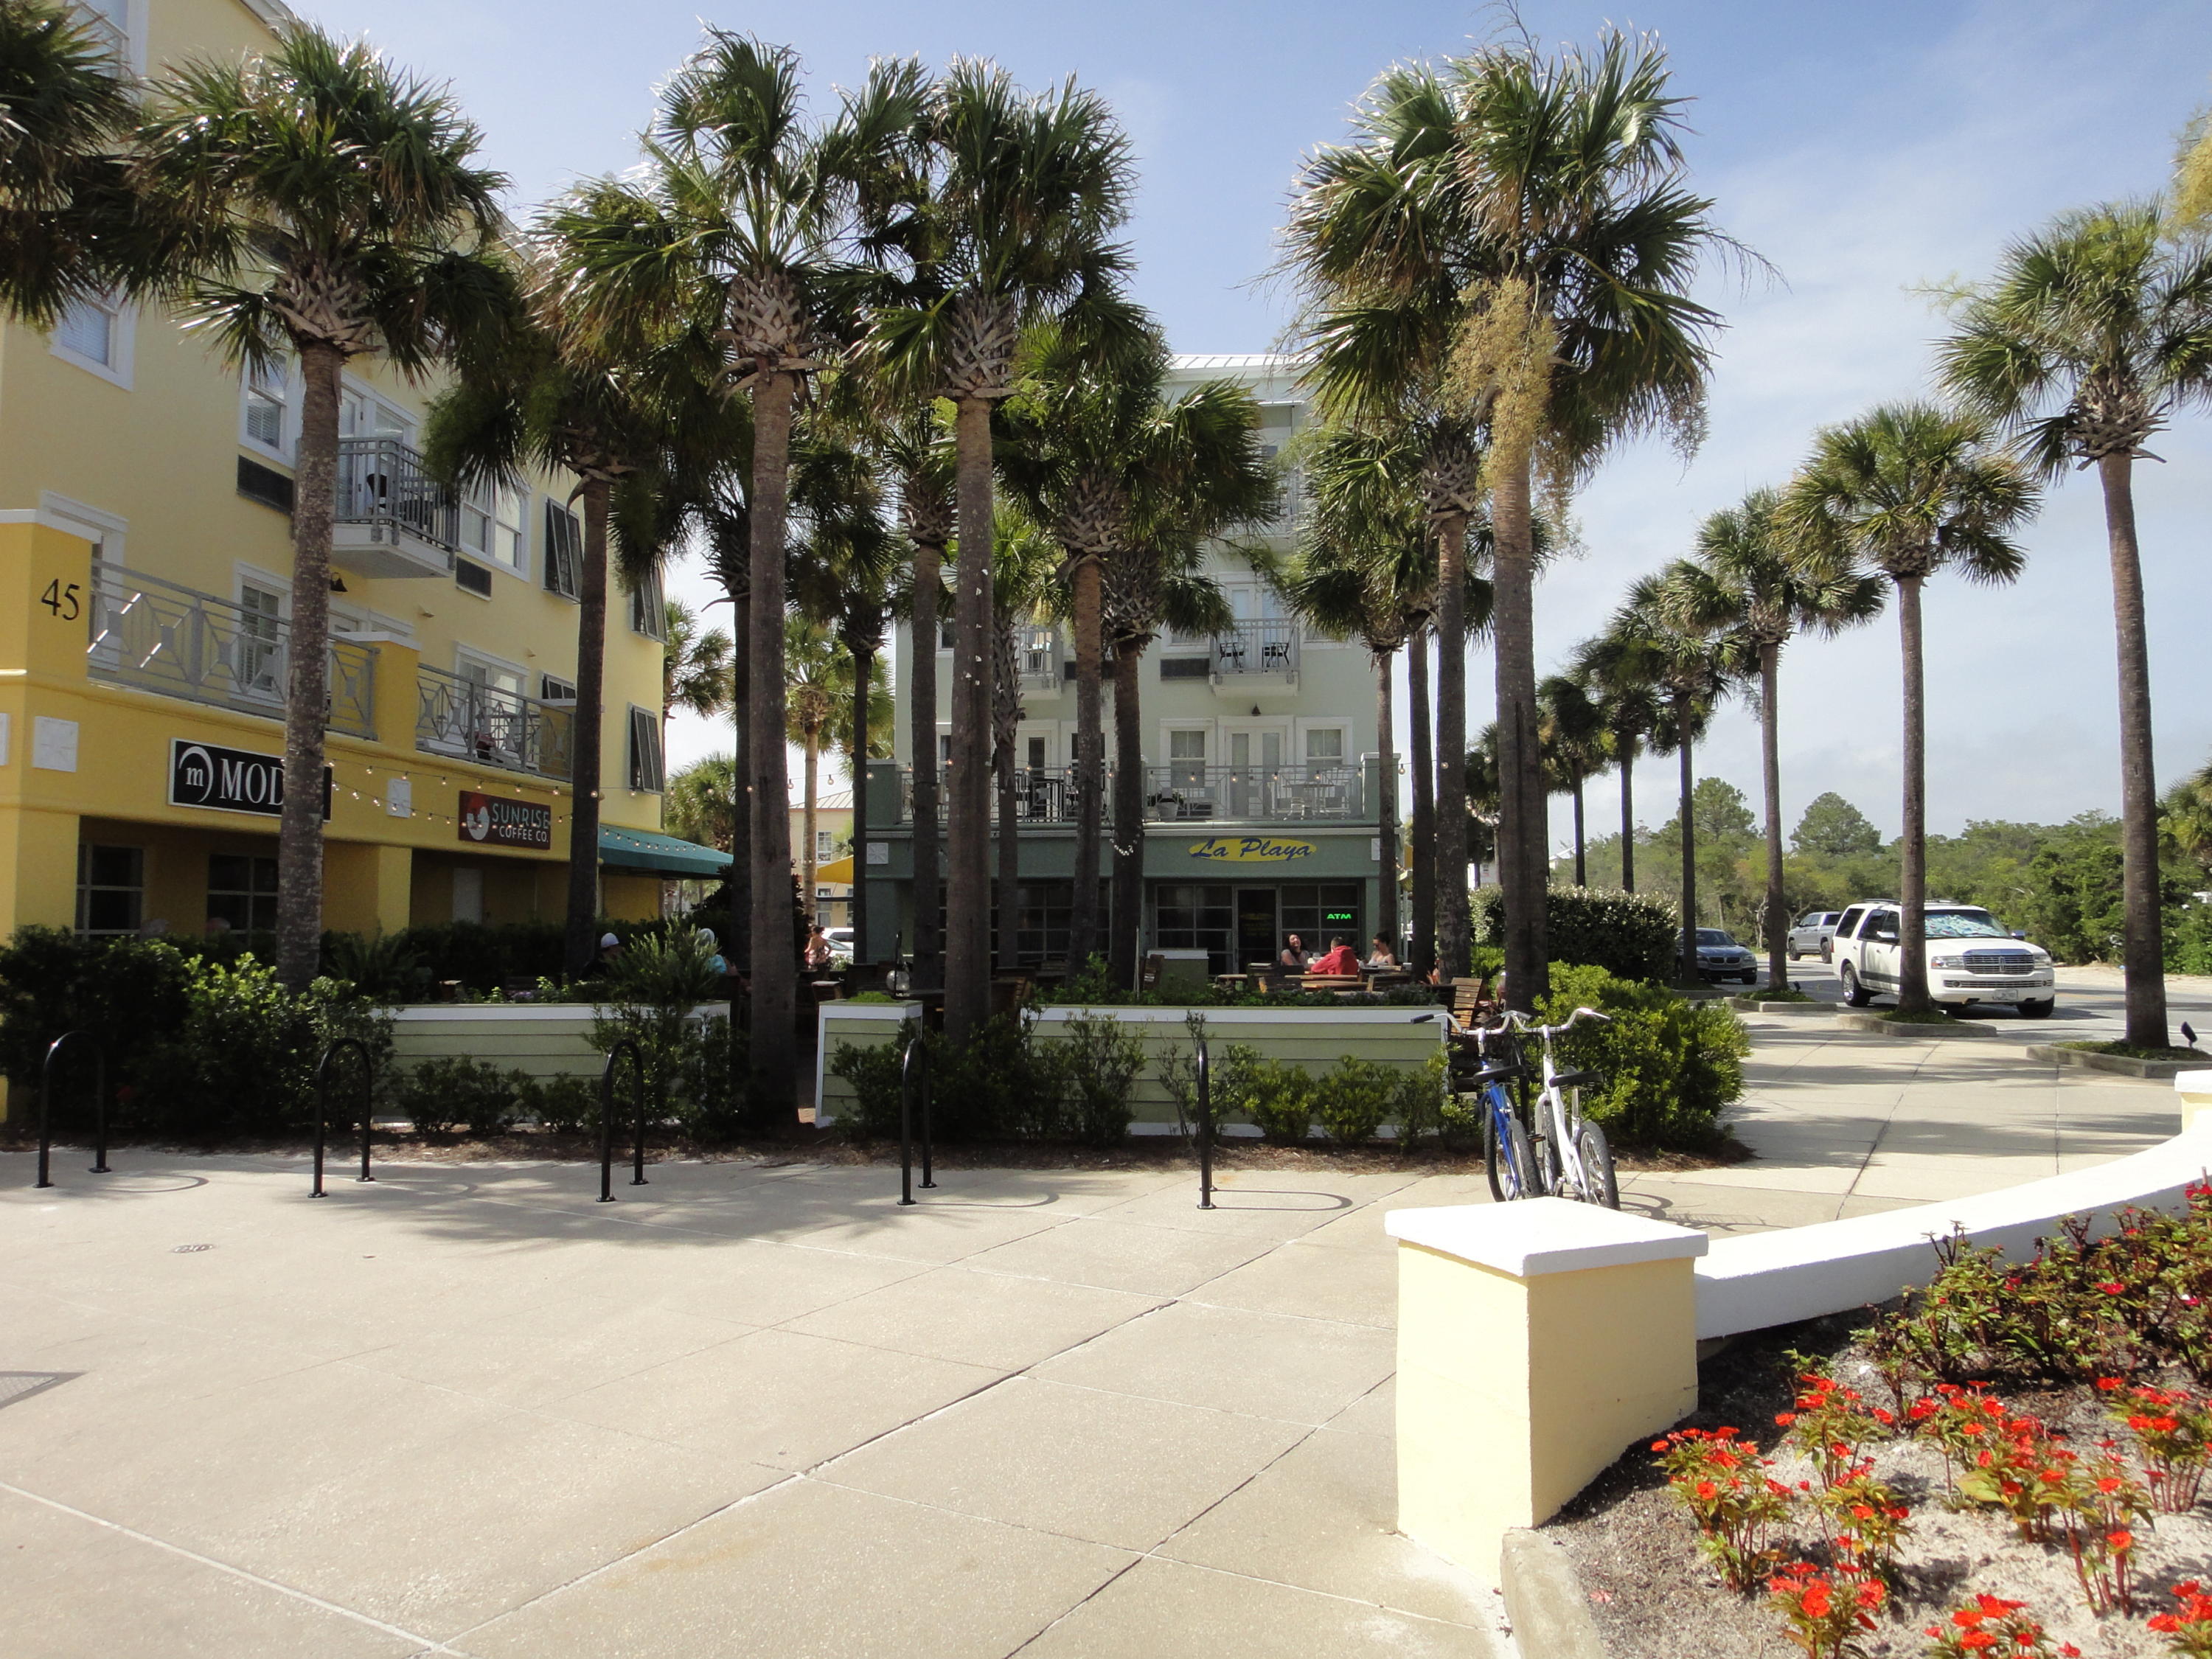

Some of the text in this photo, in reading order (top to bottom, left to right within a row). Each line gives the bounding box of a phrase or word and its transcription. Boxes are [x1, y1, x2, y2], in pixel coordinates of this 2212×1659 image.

[41, 579, 80, 620] 45
[219, 759, 285, 806] MOD
[492, 803, 549, 829] SUNRISE
[499, 826, 549, 843] COFFEE CO.
[1191, 838, 1313, 861] La Playa
